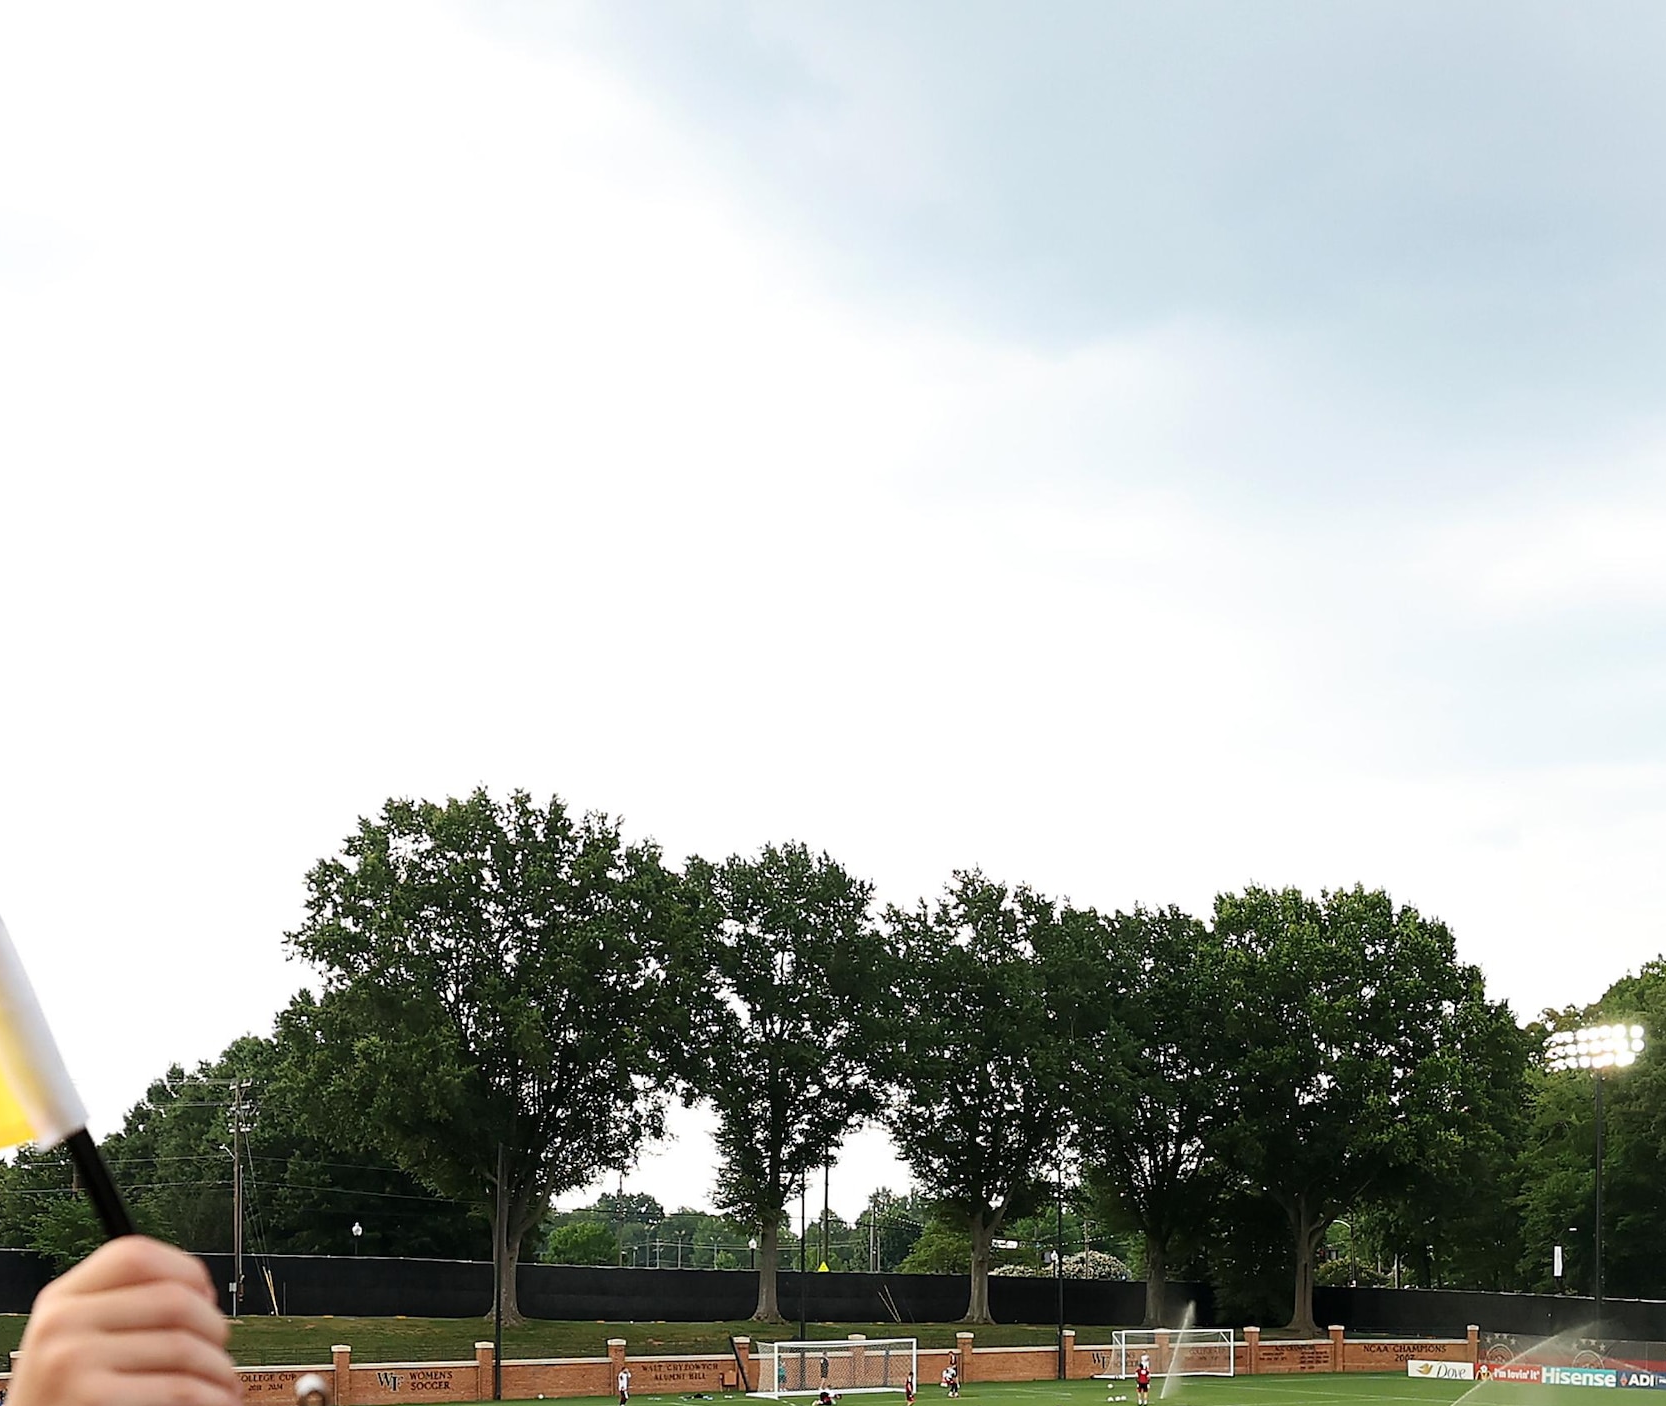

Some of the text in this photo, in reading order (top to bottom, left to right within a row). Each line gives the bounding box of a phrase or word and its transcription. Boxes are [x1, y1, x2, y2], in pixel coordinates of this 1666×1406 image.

[1363, 1345, 1447, 1353] NCAA CHAMPIONS
[1436, 1362, 1466, 1379] Dove
[240, 1374, 275, 1383] OLLEGE
[409, 1371, 453, 1380] WOMEN'S
[1541, 1366, 1617, 1387] Hisense
[410, 1381, 451, 1391] SOCCER
